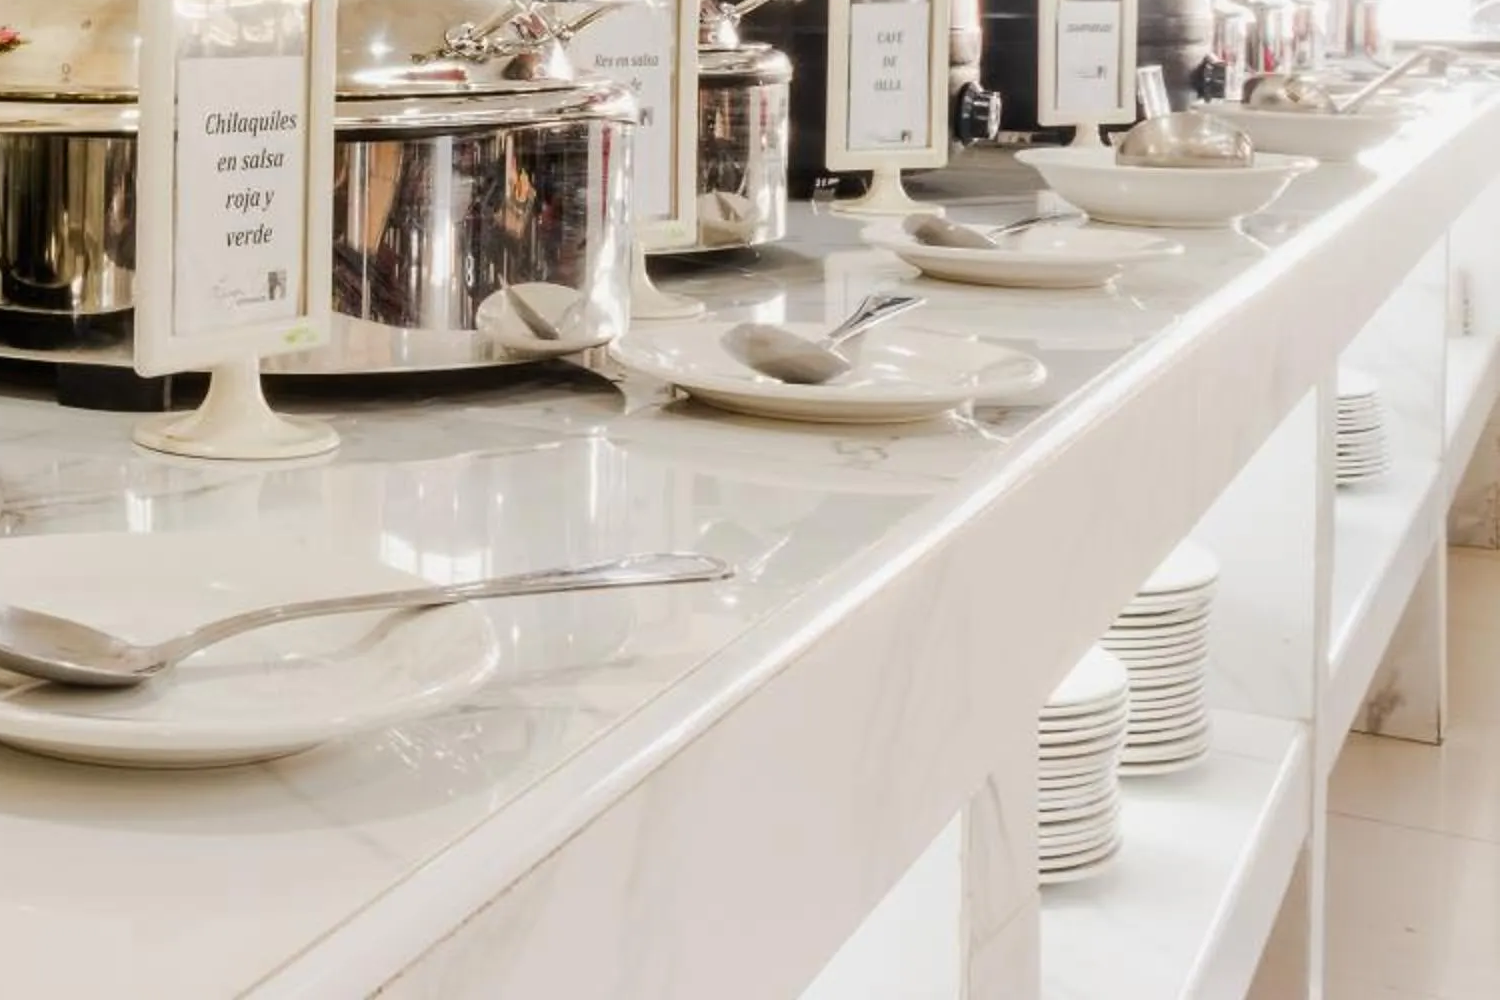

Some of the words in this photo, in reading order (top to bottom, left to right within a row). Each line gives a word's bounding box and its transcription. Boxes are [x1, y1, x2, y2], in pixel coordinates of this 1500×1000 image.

[205, 109, 298, 137] Chilaquiles
[217, 153, 238, 173] en
[241, 147, 285, 171] salsa
[225, 187, 261, 214] roja
[261, 189, 275, 212] y
[225, 222, 273, 247] verde
